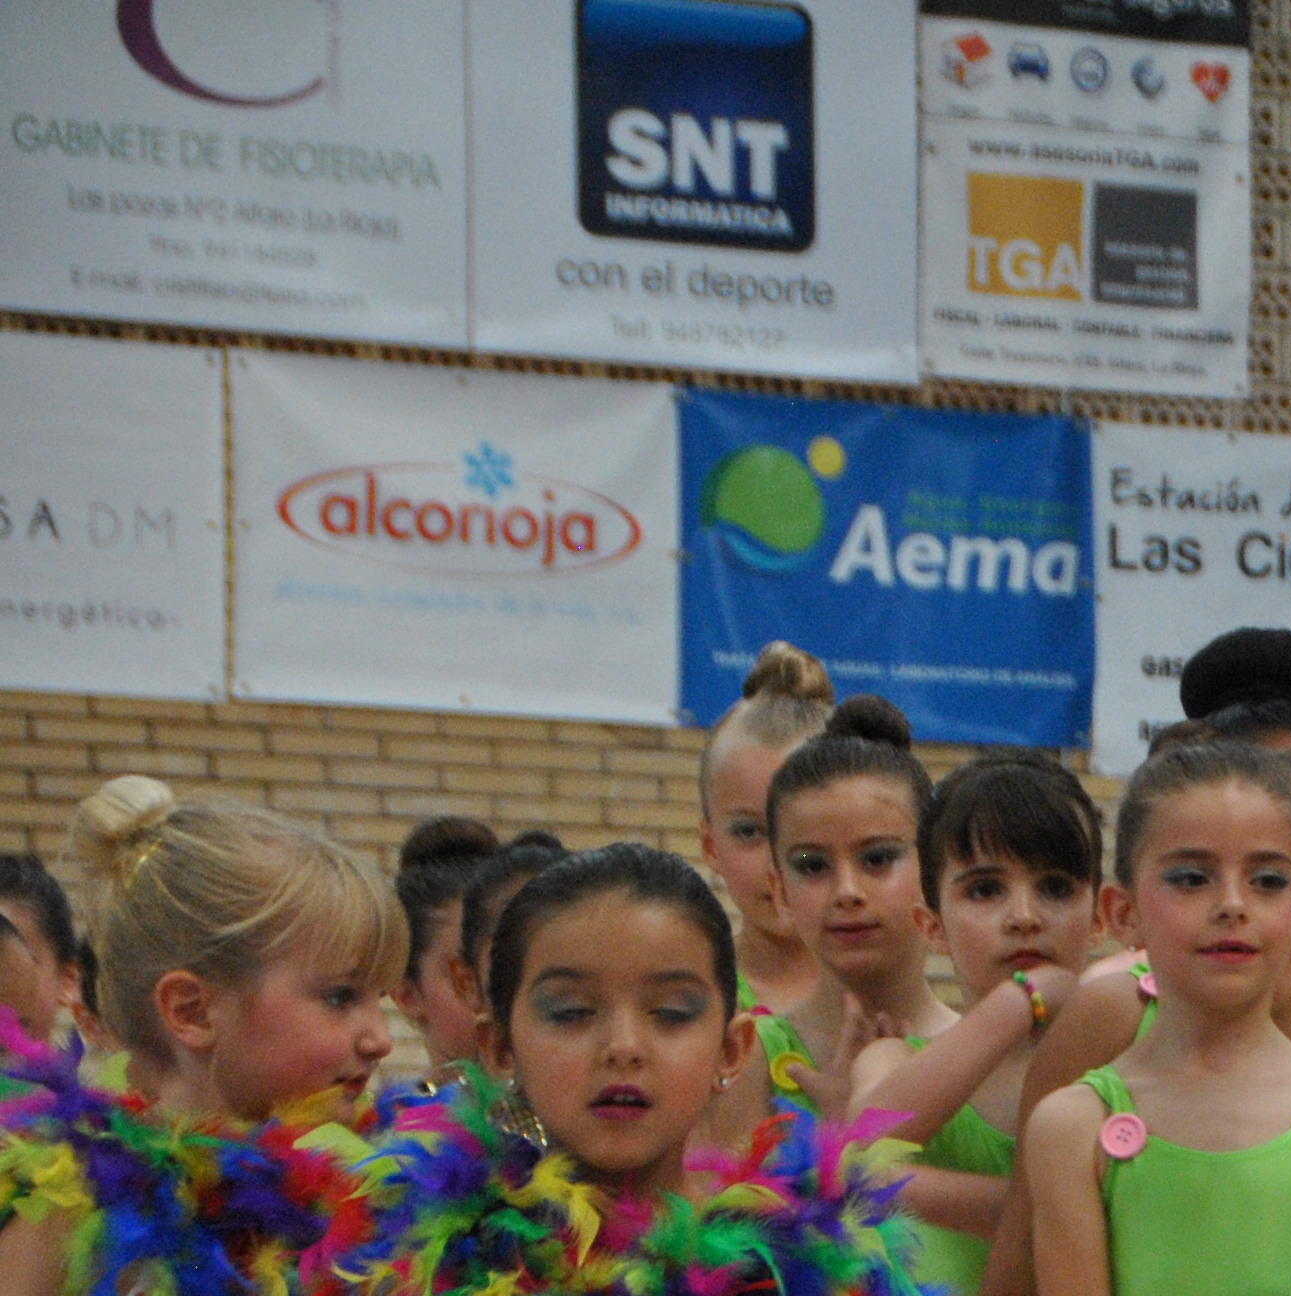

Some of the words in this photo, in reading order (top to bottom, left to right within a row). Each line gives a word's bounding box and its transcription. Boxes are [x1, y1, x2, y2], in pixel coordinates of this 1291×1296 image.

[11, 112, 170, 167] GABINETE
[180, 129, 224, 173] DE
[239, 134, 443, 191] FISIOTERAPIA
[605, 106, 790, 198] SNT
[606, 194, 793, 236] INFORMATICA
[556, 258, 627, 290] con
[641, 261, 674, 294] el
[687, 262, 836, 308] deporte
[969, 236, 1083, 291] TGA
[1109, 467, 1262, 514] Estación
[87, 500, 177, 550] DM
[828, 503, 1080, 598] Aema
[1108, 523, 1203, 575] Las
